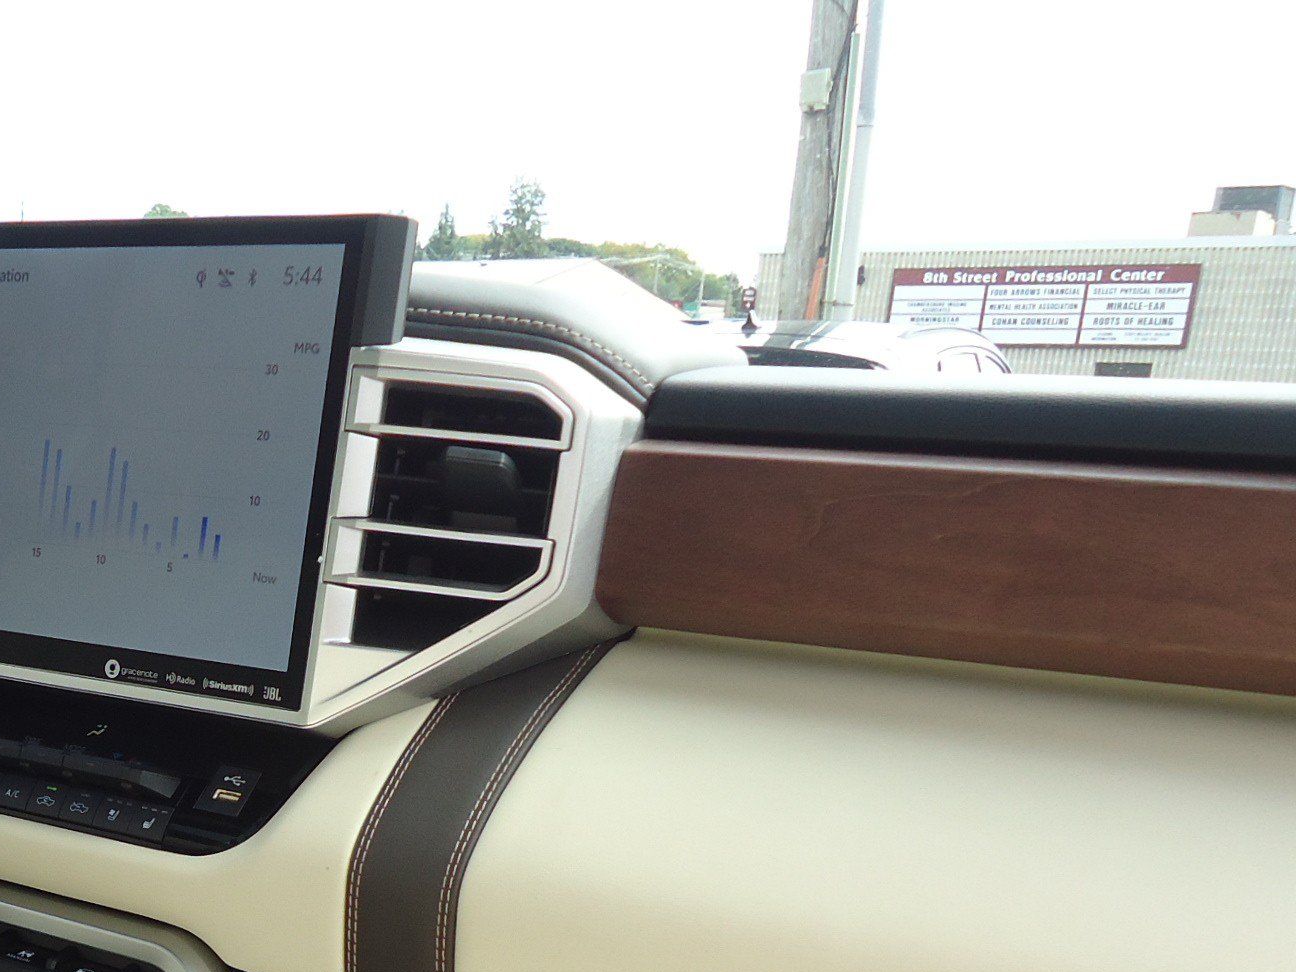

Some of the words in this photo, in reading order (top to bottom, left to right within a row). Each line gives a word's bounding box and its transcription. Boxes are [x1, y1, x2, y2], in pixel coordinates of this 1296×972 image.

[282, 265, 323, 286] 5:44
[923, 271, 949, 284] 8th
[953, 270, 998, 284] Street
[1005, 269, 1103, 283] Professional
[1110, 268, 1165, 282] Center
[1043, 287, 1080, 295] FINANCIAL
[1119, 287, 1151, 295] PHYSICAL
[1154, 286, 1186, 295] THERAPY
[1038, 302, 1078, 310] ASSOCIATION
[1106, 301, 1166, 311] MIRACLE-EAR
[1020, 317, 1070, 326] COUNSELING
[1092, 316, 1120, 326] ROOTS
[1123, 317, 1134, 325] OF
[1137, 316, 1174, 326] HEALING
[293, 342, 320, 355] MPG
[265, 363, 279, 376] 30
[256, 430, 270, 442] 20
[249, 495, 260, 506] 10
[32, 547, 42, 558] 15
[95, 554, 107, 565] 10
[166, 562, 173, 572] 5
[252, 571, 277, 586] Now
[120, 667, 159, 680] gracenote
[176, 675, 196, 686] Radio
[262, 685, 282, 701] JBL
[4, 788, 21, 799] A/C
